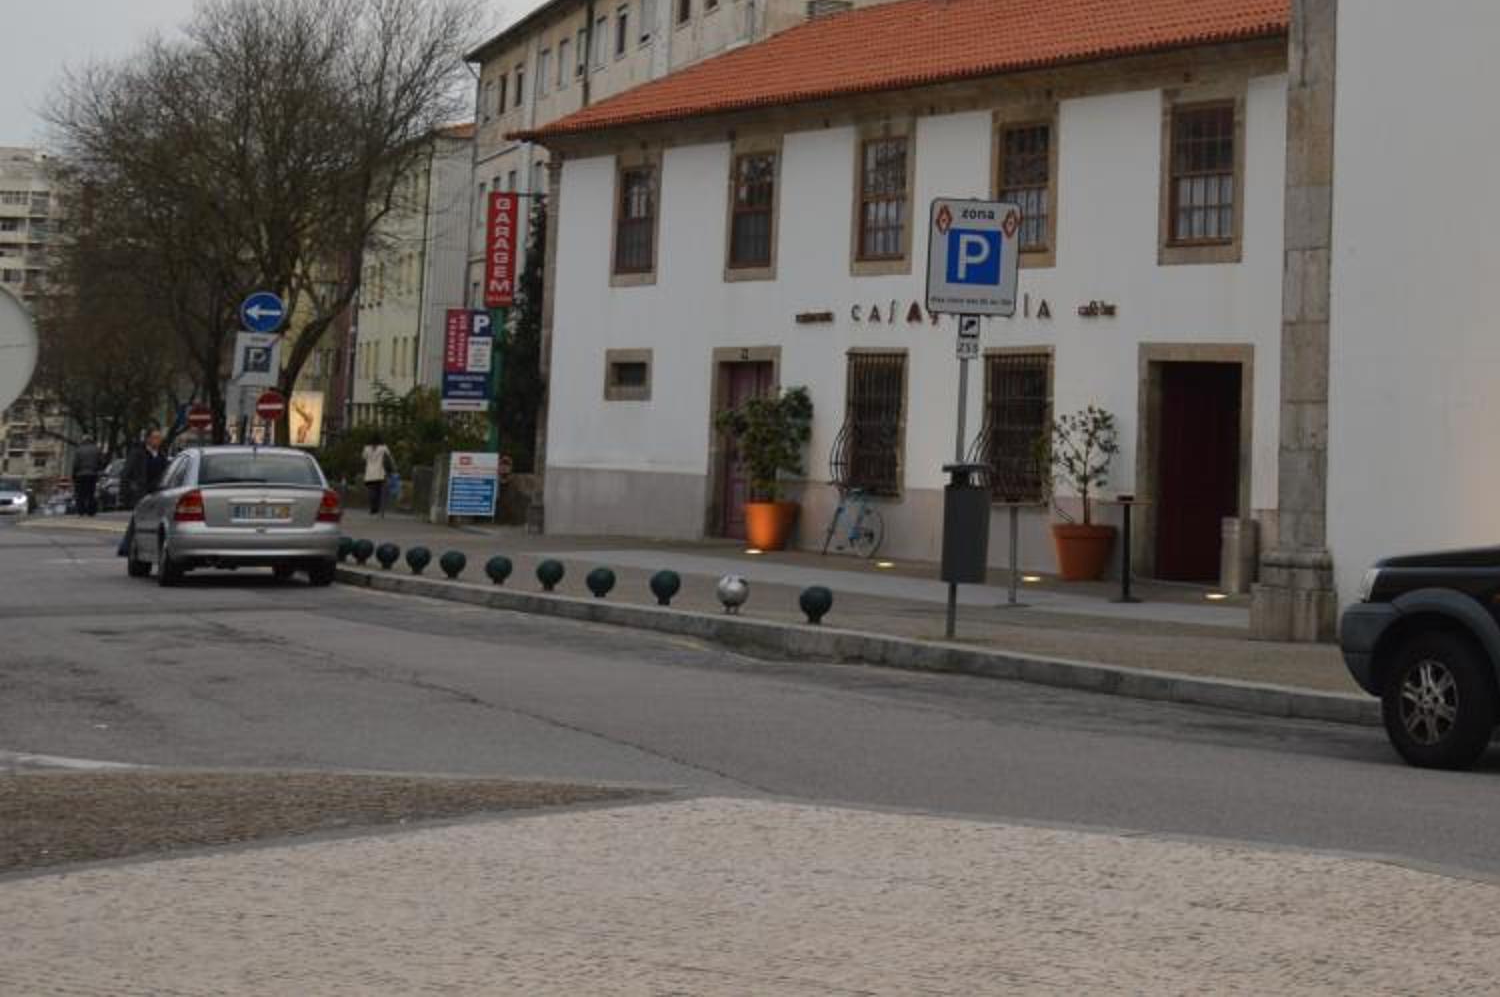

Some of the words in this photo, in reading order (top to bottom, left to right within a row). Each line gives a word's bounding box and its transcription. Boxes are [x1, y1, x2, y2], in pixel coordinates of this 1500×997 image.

[961, 208, 995, 220] zona
[489, 197, 511, 292] GARAGEM
[957, 234, 990, 280] P
[473, 314, 490, 334] P
